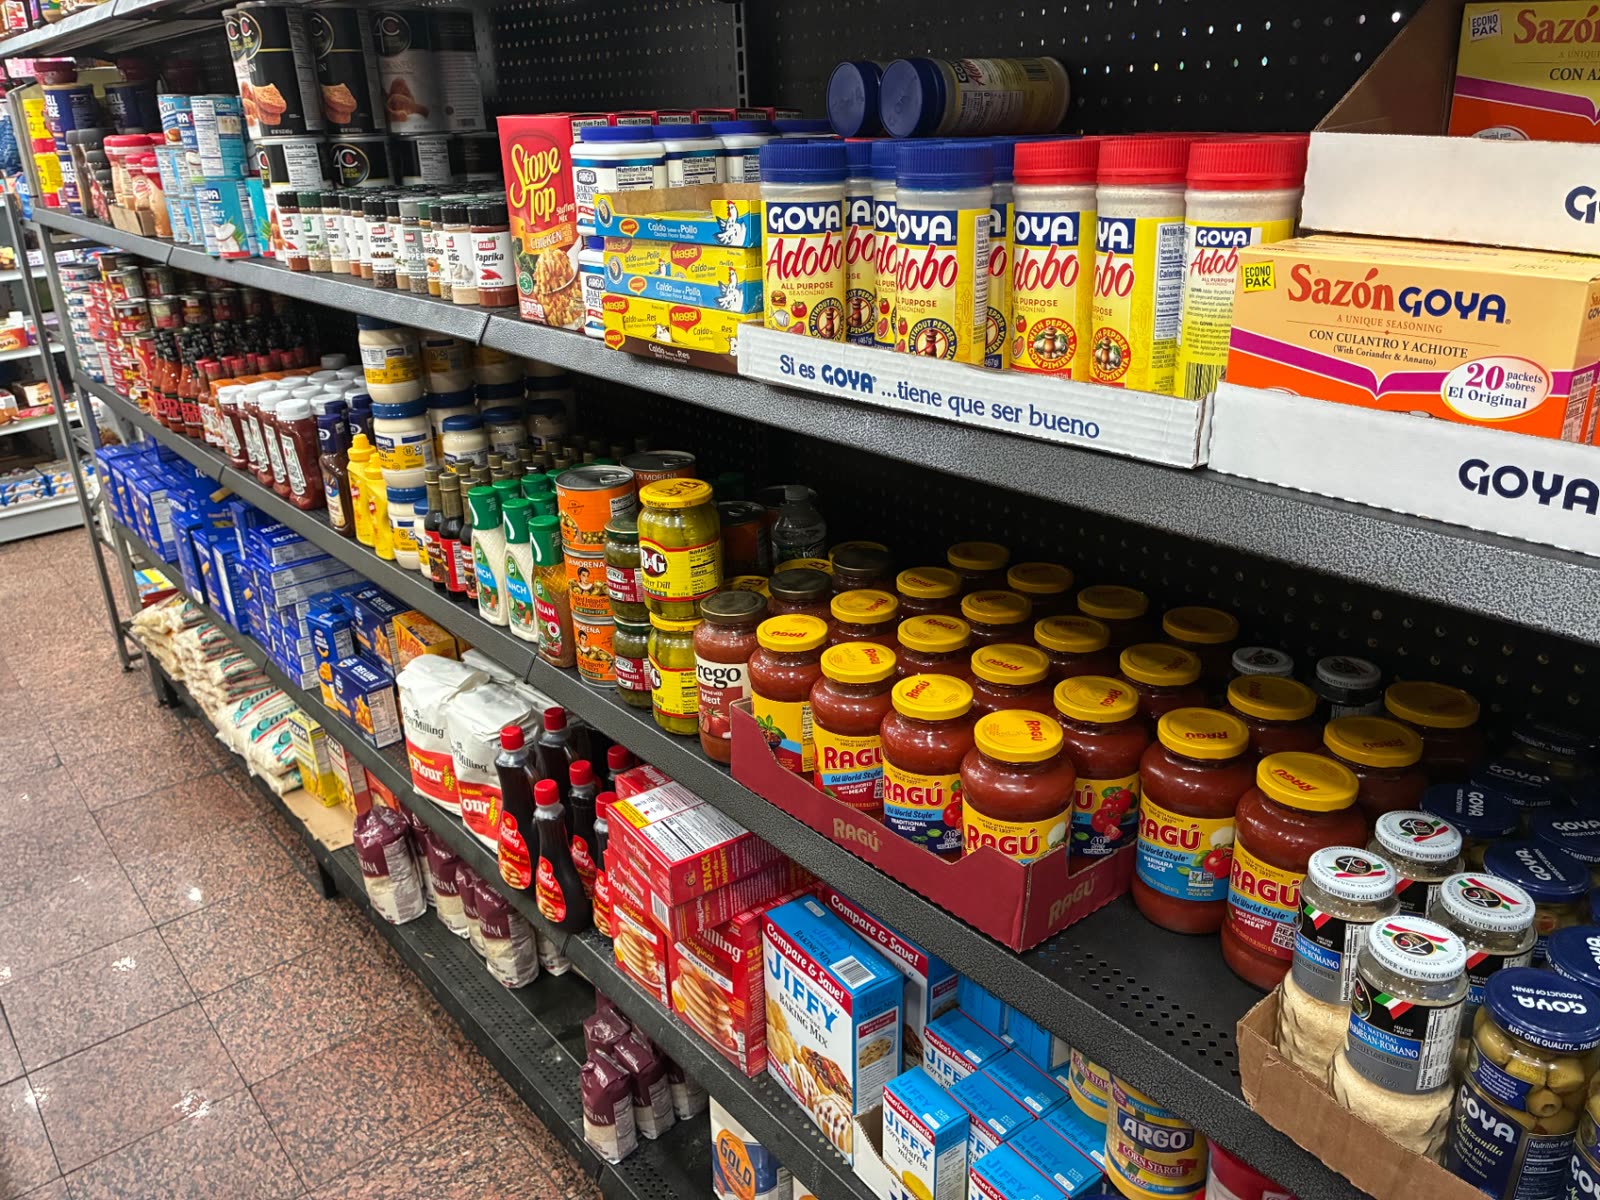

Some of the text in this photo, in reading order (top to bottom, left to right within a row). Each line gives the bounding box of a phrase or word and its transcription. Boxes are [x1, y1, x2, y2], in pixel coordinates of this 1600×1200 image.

[1472, 14, 1498, 28] ECONO
[1472, 26, 1497, 37] PAK
[1549, 68, 1584, 81] CON
[510, 144, 562, 208] Stove
[526, 186, 556, 225] Top
[769, 204, 841, 233] GOYA
[897, 215, 952, 241] OYA
[1015, 214, 1075, 242] OYA
[1196, 229, 1248, 247] GOYA
[476, 253, 504, 263] Paprika
[766, 230, 843, 281] Adobo
[1189, 246, 1240, 277] Adob
[1244, 264, 1272, 279] ECONO
[1244, 276, 1272, 289] PAK
[781, 281, 834, 290] ALL PURPOSE
[1287, 263, 1507, 324] Sazón GOYA
[902, 299, 937, 308] PURPOSE
[1019, 298, 1058, 308] PURPOSE
[909, 319, 956, 347] WITHOUT PEPPER
[1028, 318, 1074, 342] WITH PEPPER
[1336, 313, 1443, 335] A UNIQUE SEASONING
[1028, 343, 1076, 370] CON PIMIENTA
[1309, 329, 1468, 359] CON CULANTRO Y ACHIOTE
[1333, 344, 1437, 368] (With Coriander & Annatto)
[1465, 363, 1506, 391] 20
[1506, 370, 1543, 385] packets
[1504, 381, 1536, 393] sobres
[780, 354, 795, 374] Si
[799, 363, 816, 379] es
[821, 363, 872, 394] GOYA
[947, 395, 985, 420] que
[991, 402, 1023, 424] ser
[1029, 404, 1100, 439] bueno
[1448, 387, 1528, 410] El Original
[1458, 458, 1600, 516] GOYA
[848, 787, 867, 796] MEAT
[884, 781, 944, 808] RAGÚ
[832, 817, 883, 853] RAGÚ
[967, 823, 1041, 857] RAGÚ
[1139, 808, 1200, 851] RAGÚ
[701, 853, 714, 892] STACK
[1230, 857, 1300, 908] RAGÚ
[1328, 888, 1356, 899] POWDER
[831, 894, 920, 967] Compare & Save!
[1244, 919, 1265, 931] MEAT
[766, 923, 845, 1003] Compare & Save!
[1403, 967, 1419, 977] ALL
[1517, 995, 1588, 1015] GOYA
[779, 992, 829, 1049] BAKING MIX
[1358, 1021, 1398, 1045] ALL NATURAL
[1507, 1024, 1525, 1039] JUST
[1524, 1034, 1541, 1045] ONE
[1541, 1039, 1573, 1051] QUALITY
[883, 1089, 934, 1143] America's Favorite
[1460, 1084, 1515, 1144] GOYA
[1122, 1117, 1187, 1150] ARGO
[720, 1137, 753, 1187] GOLD
[1122, 1144, 1185, 1176] CORN STARCH
